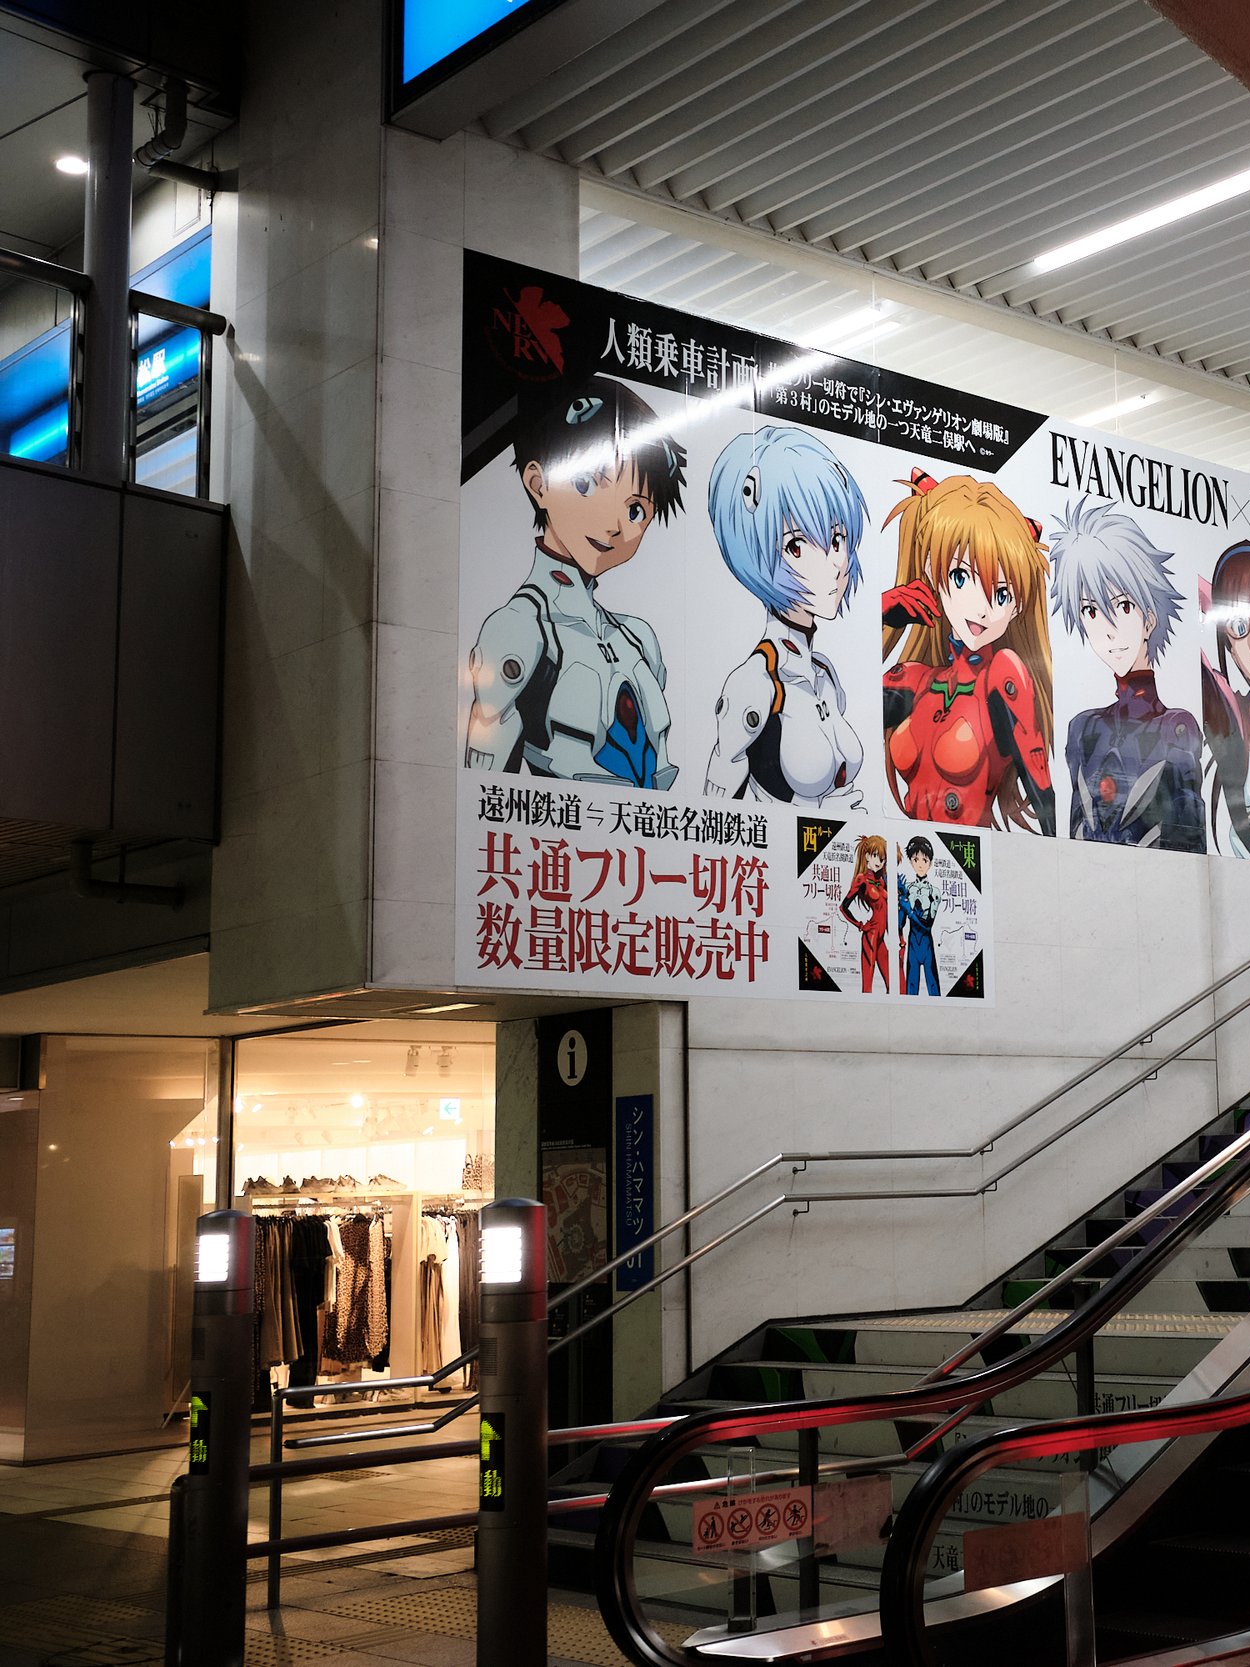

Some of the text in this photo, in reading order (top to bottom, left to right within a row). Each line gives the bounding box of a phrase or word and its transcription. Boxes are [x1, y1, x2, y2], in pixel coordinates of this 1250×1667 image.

[600, 317, 757, 394] 人類乗車計画
[1049, 430, 1230, 532] EVANGELION
[477, 784, 769, 850] 遠州鉄道 天竜浜名湖鉄道
[476, 831, 769, 918] 共通フリー切符
[802, 883, 843, 902] フリー切符
[475, 903, 770, 984] 数量限定販売中
[625, 1152, 633, 1227] HAMAMATSU
